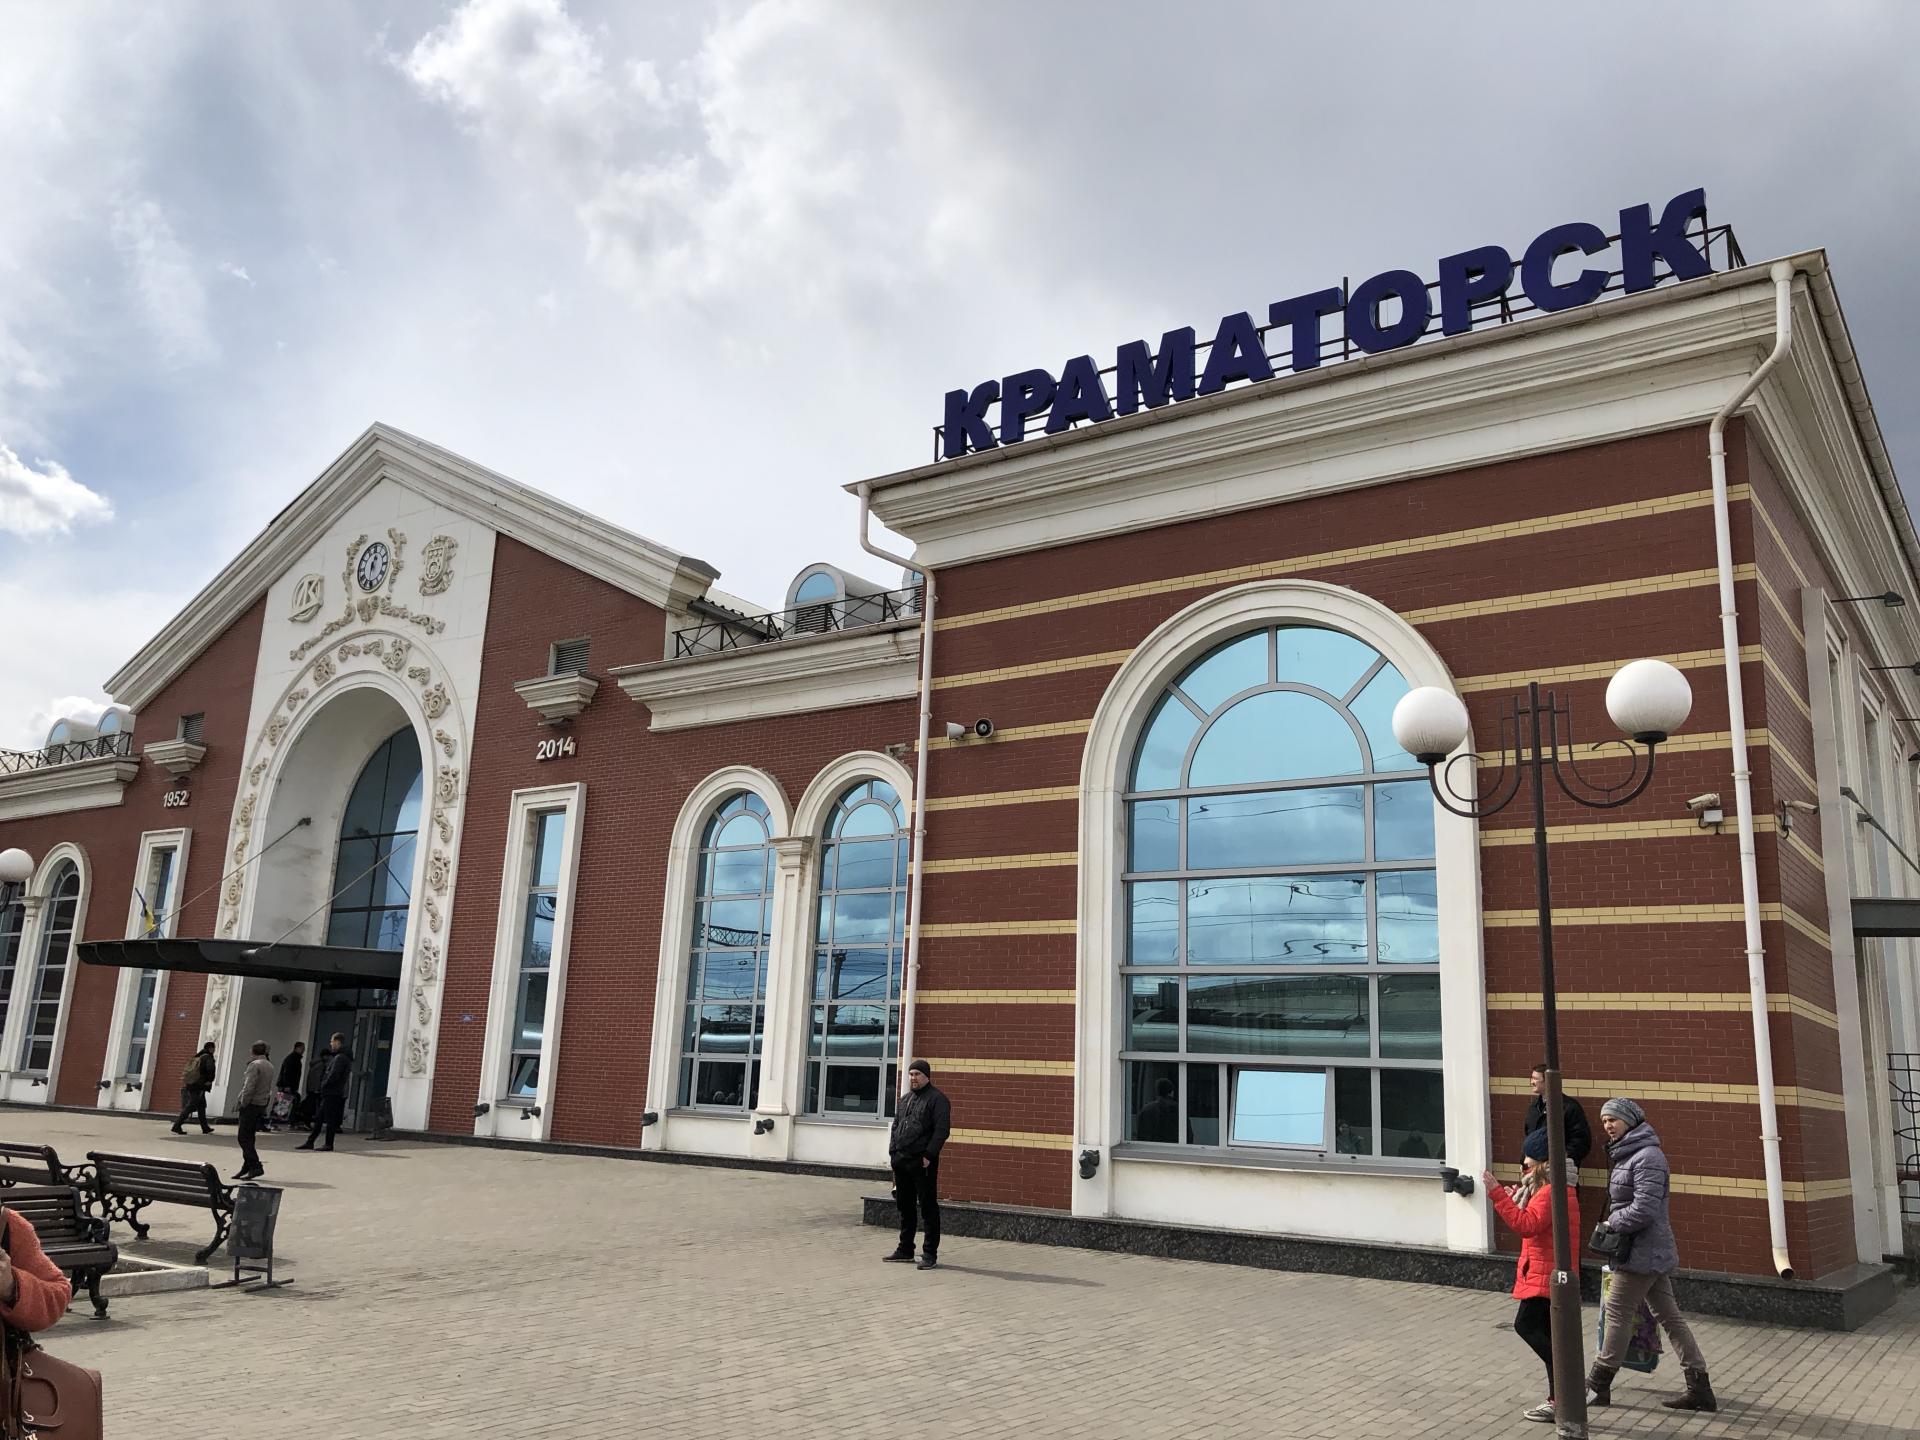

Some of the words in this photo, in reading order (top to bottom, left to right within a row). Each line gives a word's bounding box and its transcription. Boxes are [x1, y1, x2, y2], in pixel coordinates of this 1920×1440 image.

[943, 188, 1715, 459] КРАМАТОРСК
[535, 735, 576, 760] 2014
[163, 790, 189, 808] 1952
[1557, 1270, 1568, 1284] 13
